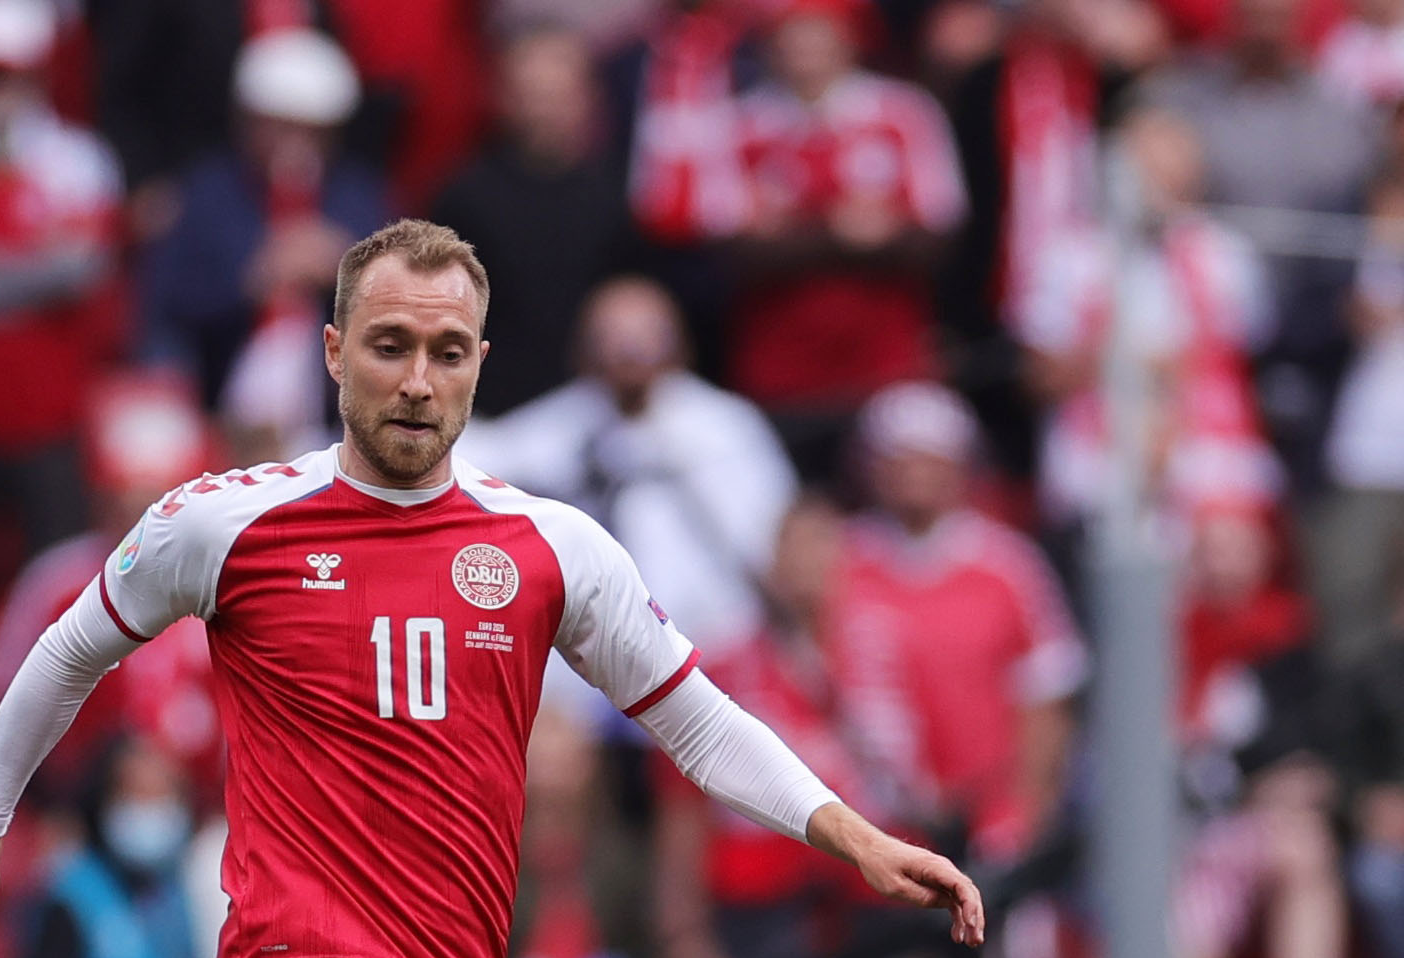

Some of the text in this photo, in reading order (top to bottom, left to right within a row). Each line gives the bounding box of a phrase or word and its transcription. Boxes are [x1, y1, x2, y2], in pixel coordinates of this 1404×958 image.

[302, 577, 345, 590] hummel
[466, 565, 505, 585] DBU
[370, 616, 446, 720] 10
